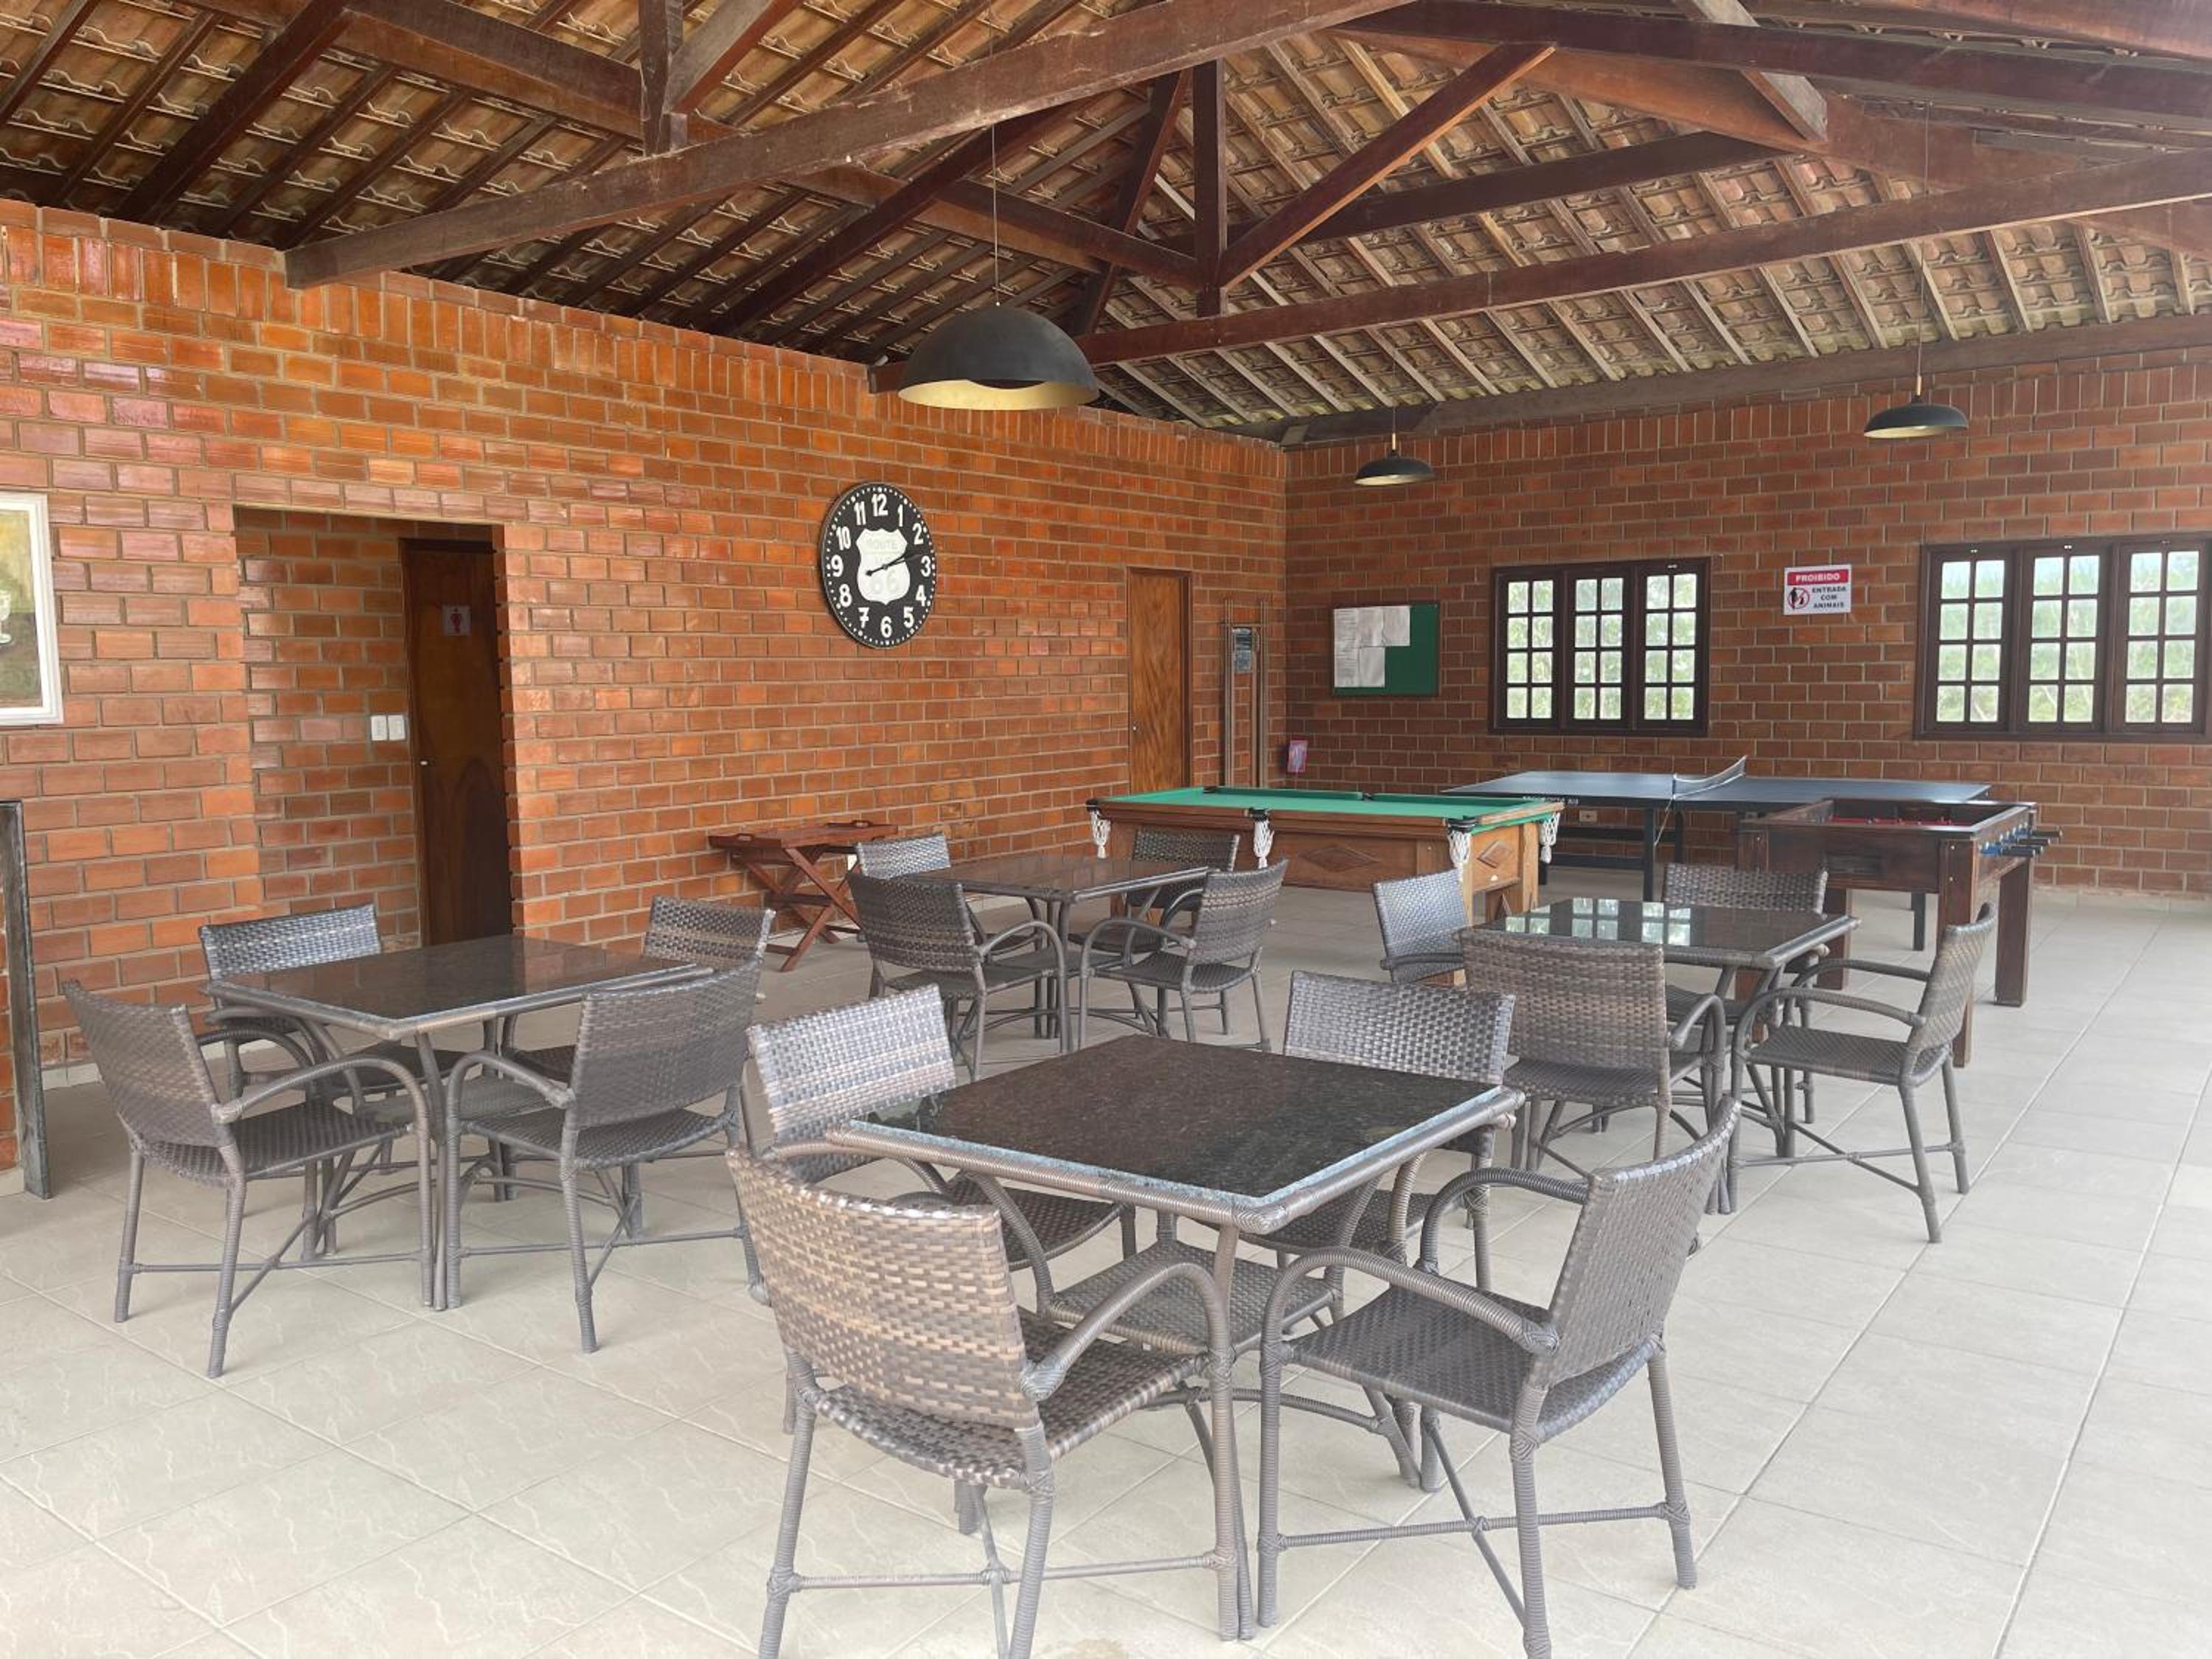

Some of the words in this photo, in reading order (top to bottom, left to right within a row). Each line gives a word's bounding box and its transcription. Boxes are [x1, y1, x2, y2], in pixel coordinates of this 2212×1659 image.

[854, 501, 866, 526] 11
[872, 493, 888, 517] 12
[897, 504, 903, 527] 1
[836, 526, 851, 551] 10
[912, 523, 924, 545] 2
[831, 554, 844, 577] 9
[921, 555, 931, 577] 3
[1795, 573, 1840, 582] PROIBIDO
[839, 584, 852, 608] 8
[916, 585, 927, 607] 4
[858, 607, 869, 628] 7
[880, 616, 892, 638] 6
[903, 606, 914, 628] 5
